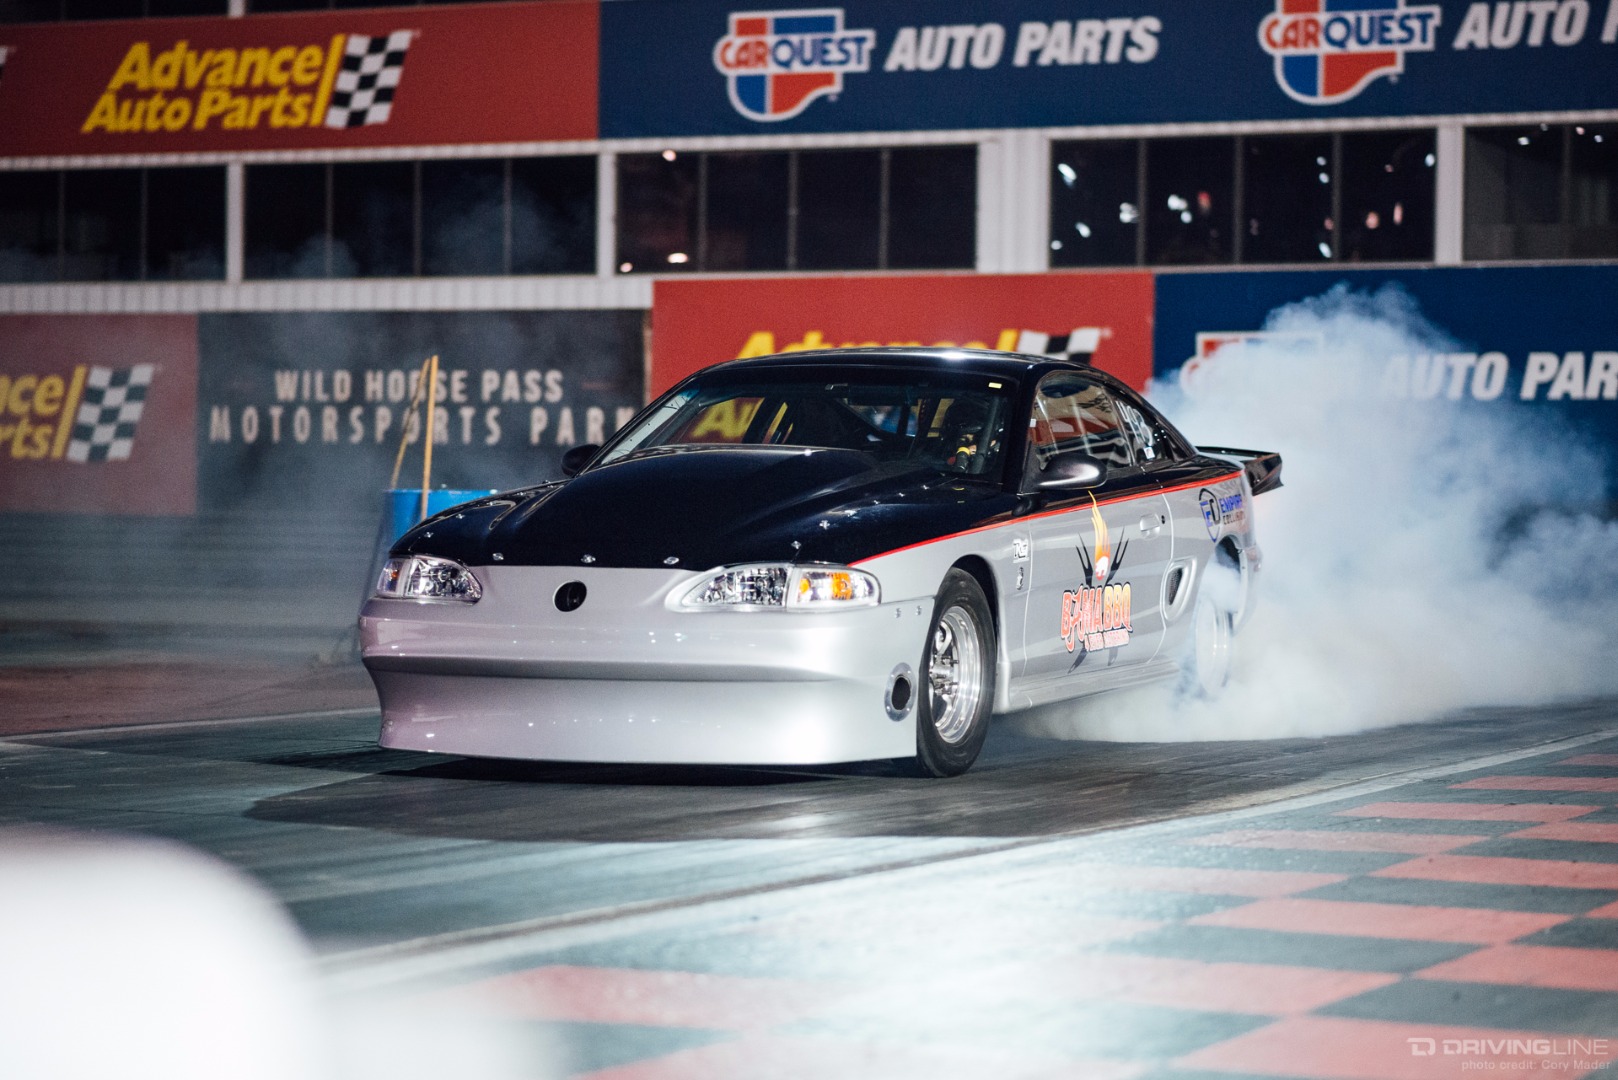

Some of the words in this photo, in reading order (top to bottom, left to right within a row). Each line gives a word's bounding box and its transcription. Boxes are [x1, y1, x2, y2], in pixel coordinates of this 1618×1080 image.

[718, 35, 868, 70] CARQUEST
[884, 23, 1005, 71] AUTO
[1013, 16, 1162, 68] PARTS
[1264, 12, 1435, 49] CARQUEST
[1452, 1, 1590, 49] AUTO
[106, 39, 323, 91] Advance
[80, 89, 192, 133] Auto
[192, 86, 313, 131] Parts
[274, 369, 352, 402] WILD
[364, 369, 469, 402] HORSE
[481, 369, 565, 402] PASS
[1382, 351, 1510, 401] AUTO
[208, 405, 501, 446] MOTORSPORTS
[1103, 582, 1133, 633] BBQ
